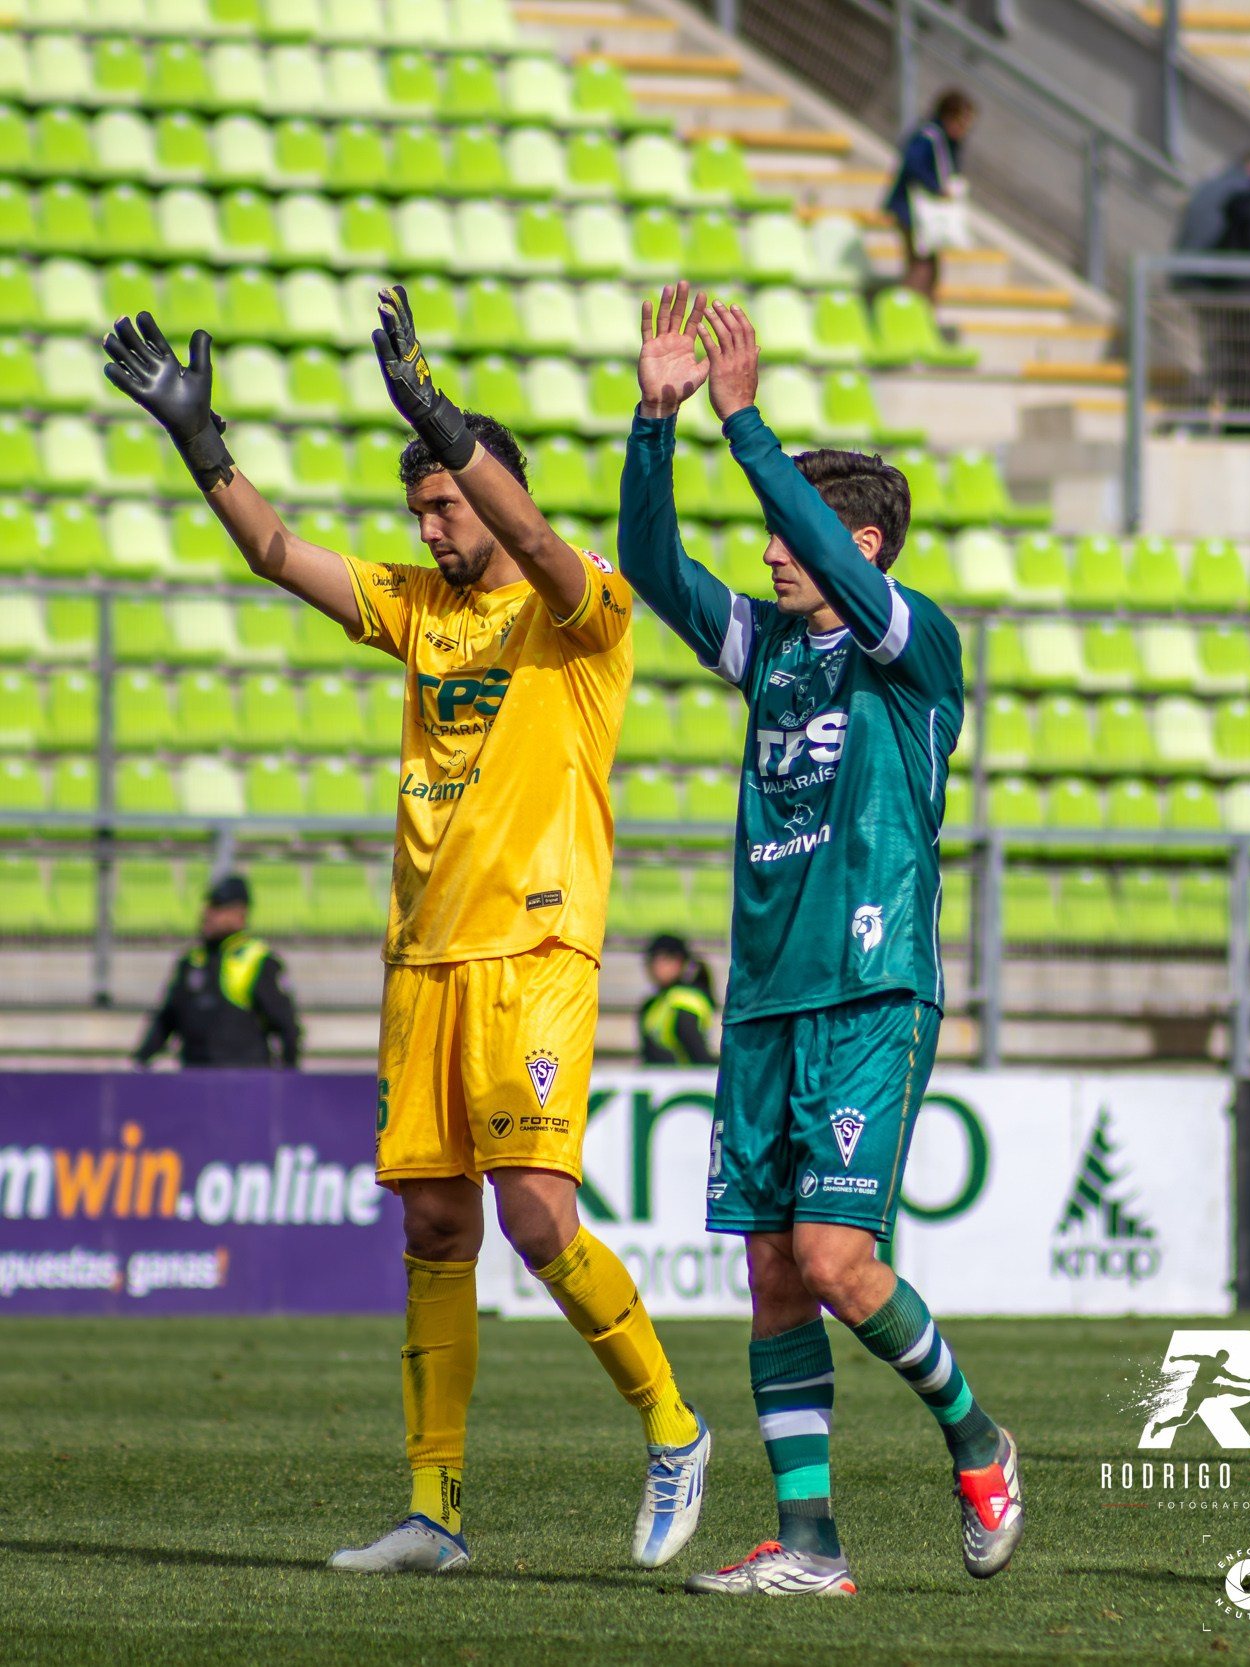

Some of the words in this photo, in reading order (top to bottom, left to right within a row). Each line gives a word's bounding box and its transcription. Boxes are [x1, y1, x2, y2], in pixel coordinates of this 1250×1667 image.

[417, 667, 512, 722] TPS
[756, 712, 848, 777] TPS
[762, 766, 837, 794] VALPARAÍS
[520, 1117, 569, 1128] FOTON
[823, 1177, 879, 1189] FOTON
